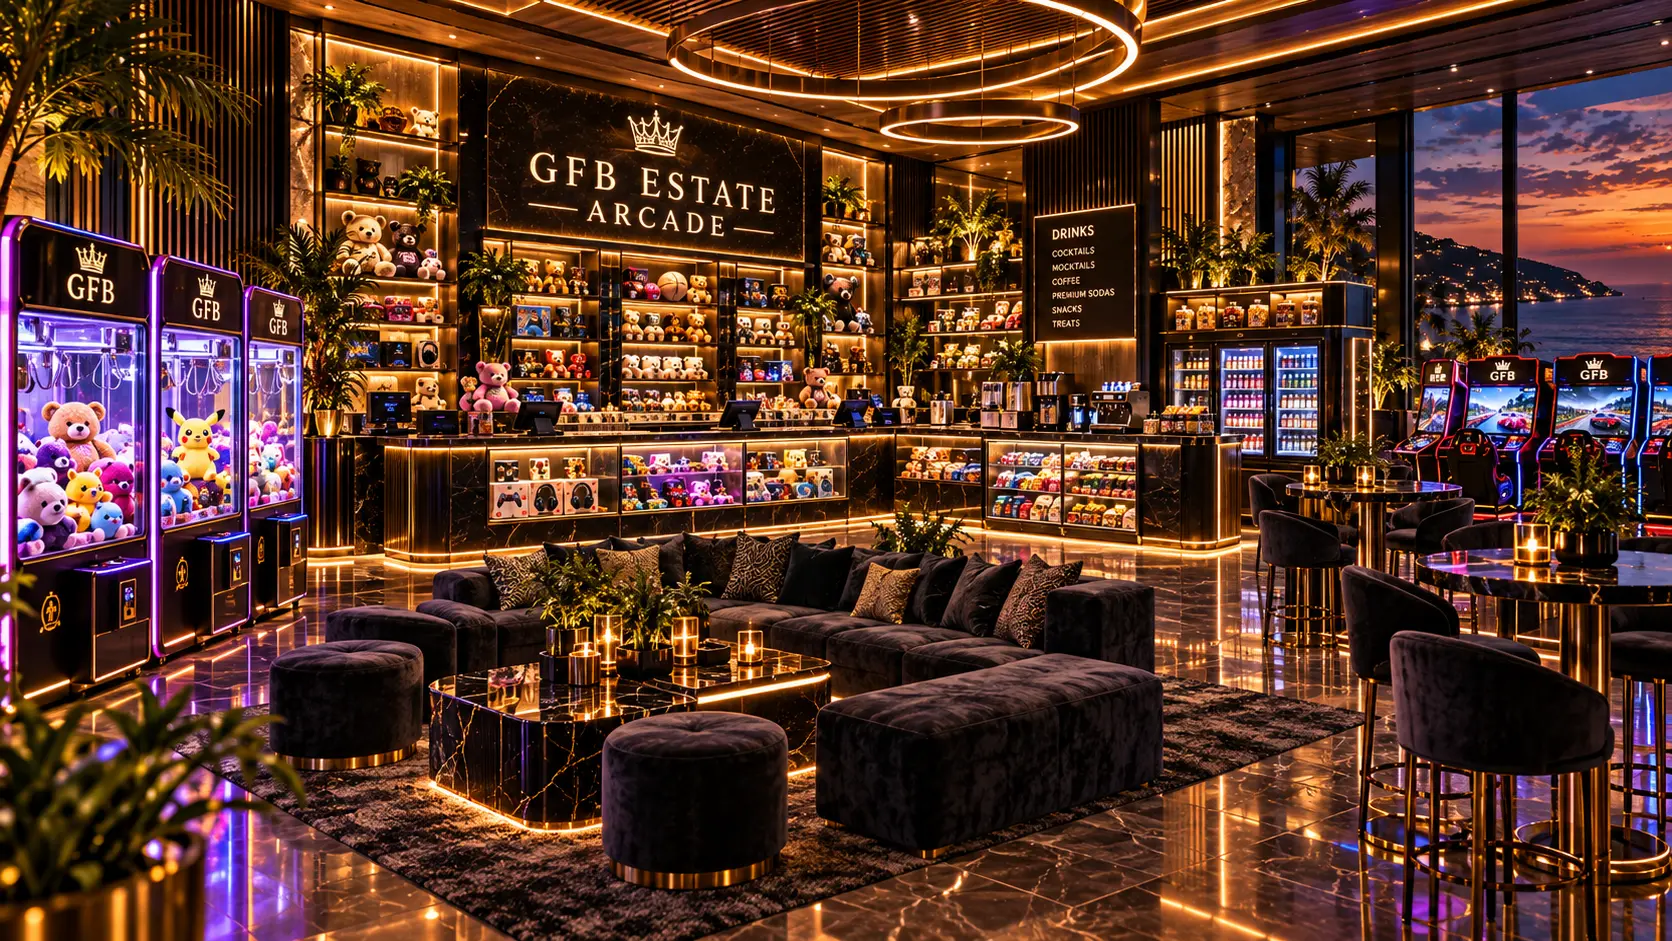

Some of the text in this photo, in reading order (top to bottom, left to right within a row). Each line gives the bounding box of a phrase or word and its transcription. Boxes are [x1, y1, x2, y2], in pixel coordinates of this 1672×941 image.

[529, 151, 776, 215] GFB ESTATE
[586, 200, 725, 237] ARCADE
[1052, 224, 1095, 240] DRINKS
[1051, 246, 1095, 258] COCKTAILS
[1052, 261, 1096, 272] MOCKTAILS
[1051, 276, 1081, 286] COFFEE
[66, 272, 115, 305] GFB
[1052, 288, 1115, 300] PREMIUM SODAS
[192, 297, 221, 322] GFB
[1051, 305, 1083, 315] SNACKS
[269, 317, 288, 336] GFB
[1051, 319, 1081, 328] TREATS
[1489, 371, 1516, 381] GFB
[1580, 369, 1609, 380] GFB
